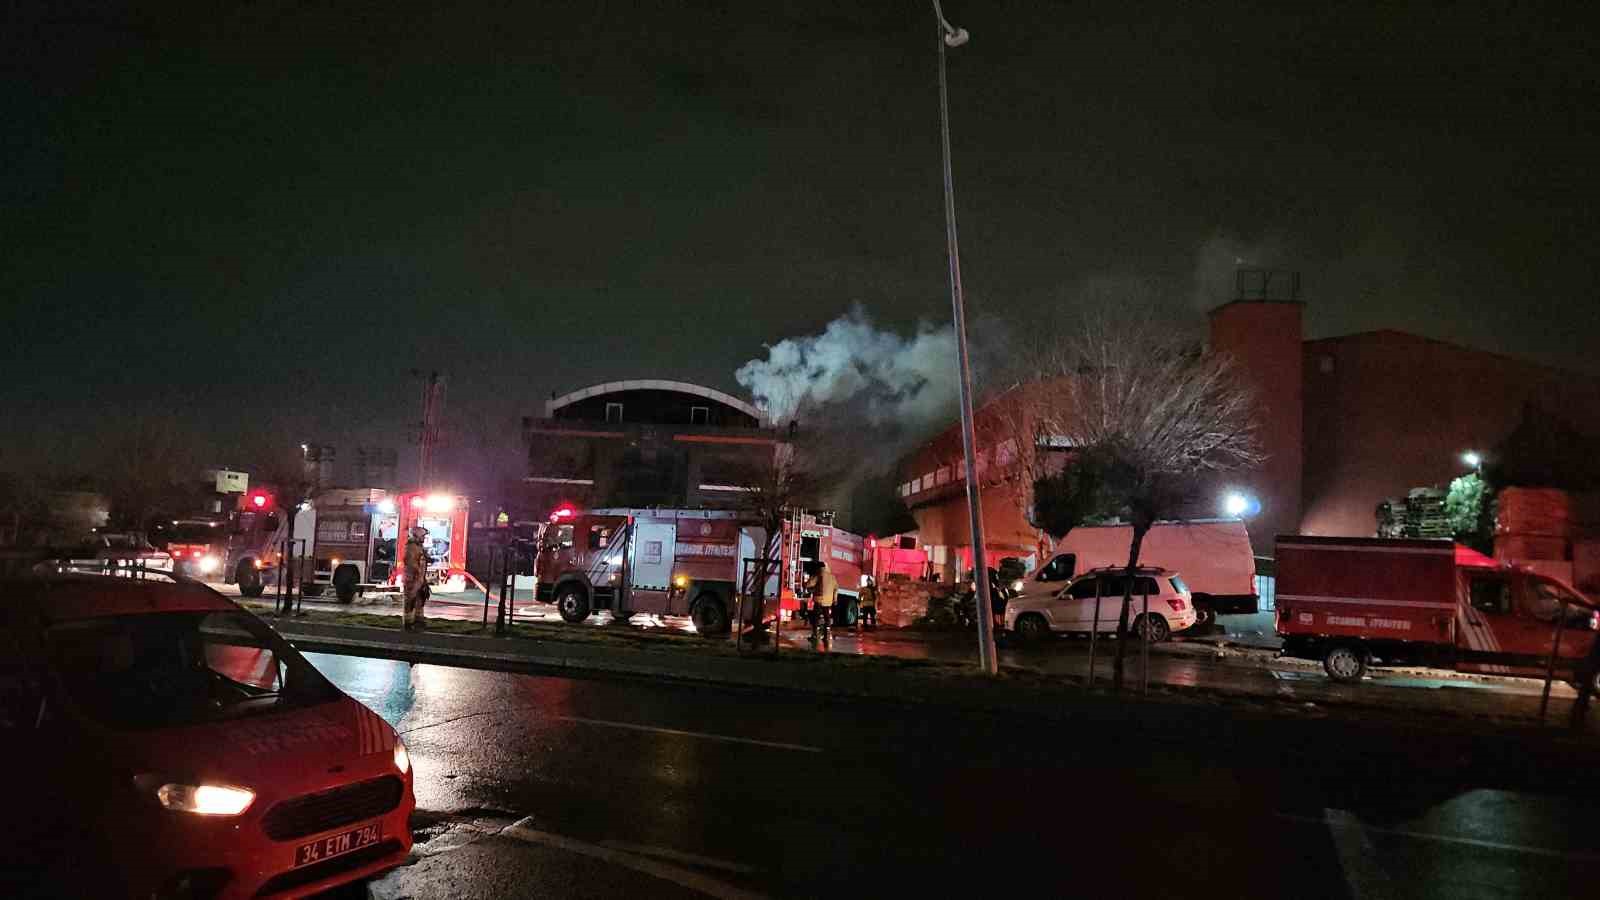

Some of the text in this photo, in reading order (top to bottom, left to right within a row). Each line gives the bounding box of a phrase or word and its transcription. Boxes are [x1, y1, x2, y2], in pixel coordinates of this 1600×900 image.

[302, 824, 378, 864] 34 ETM 794
